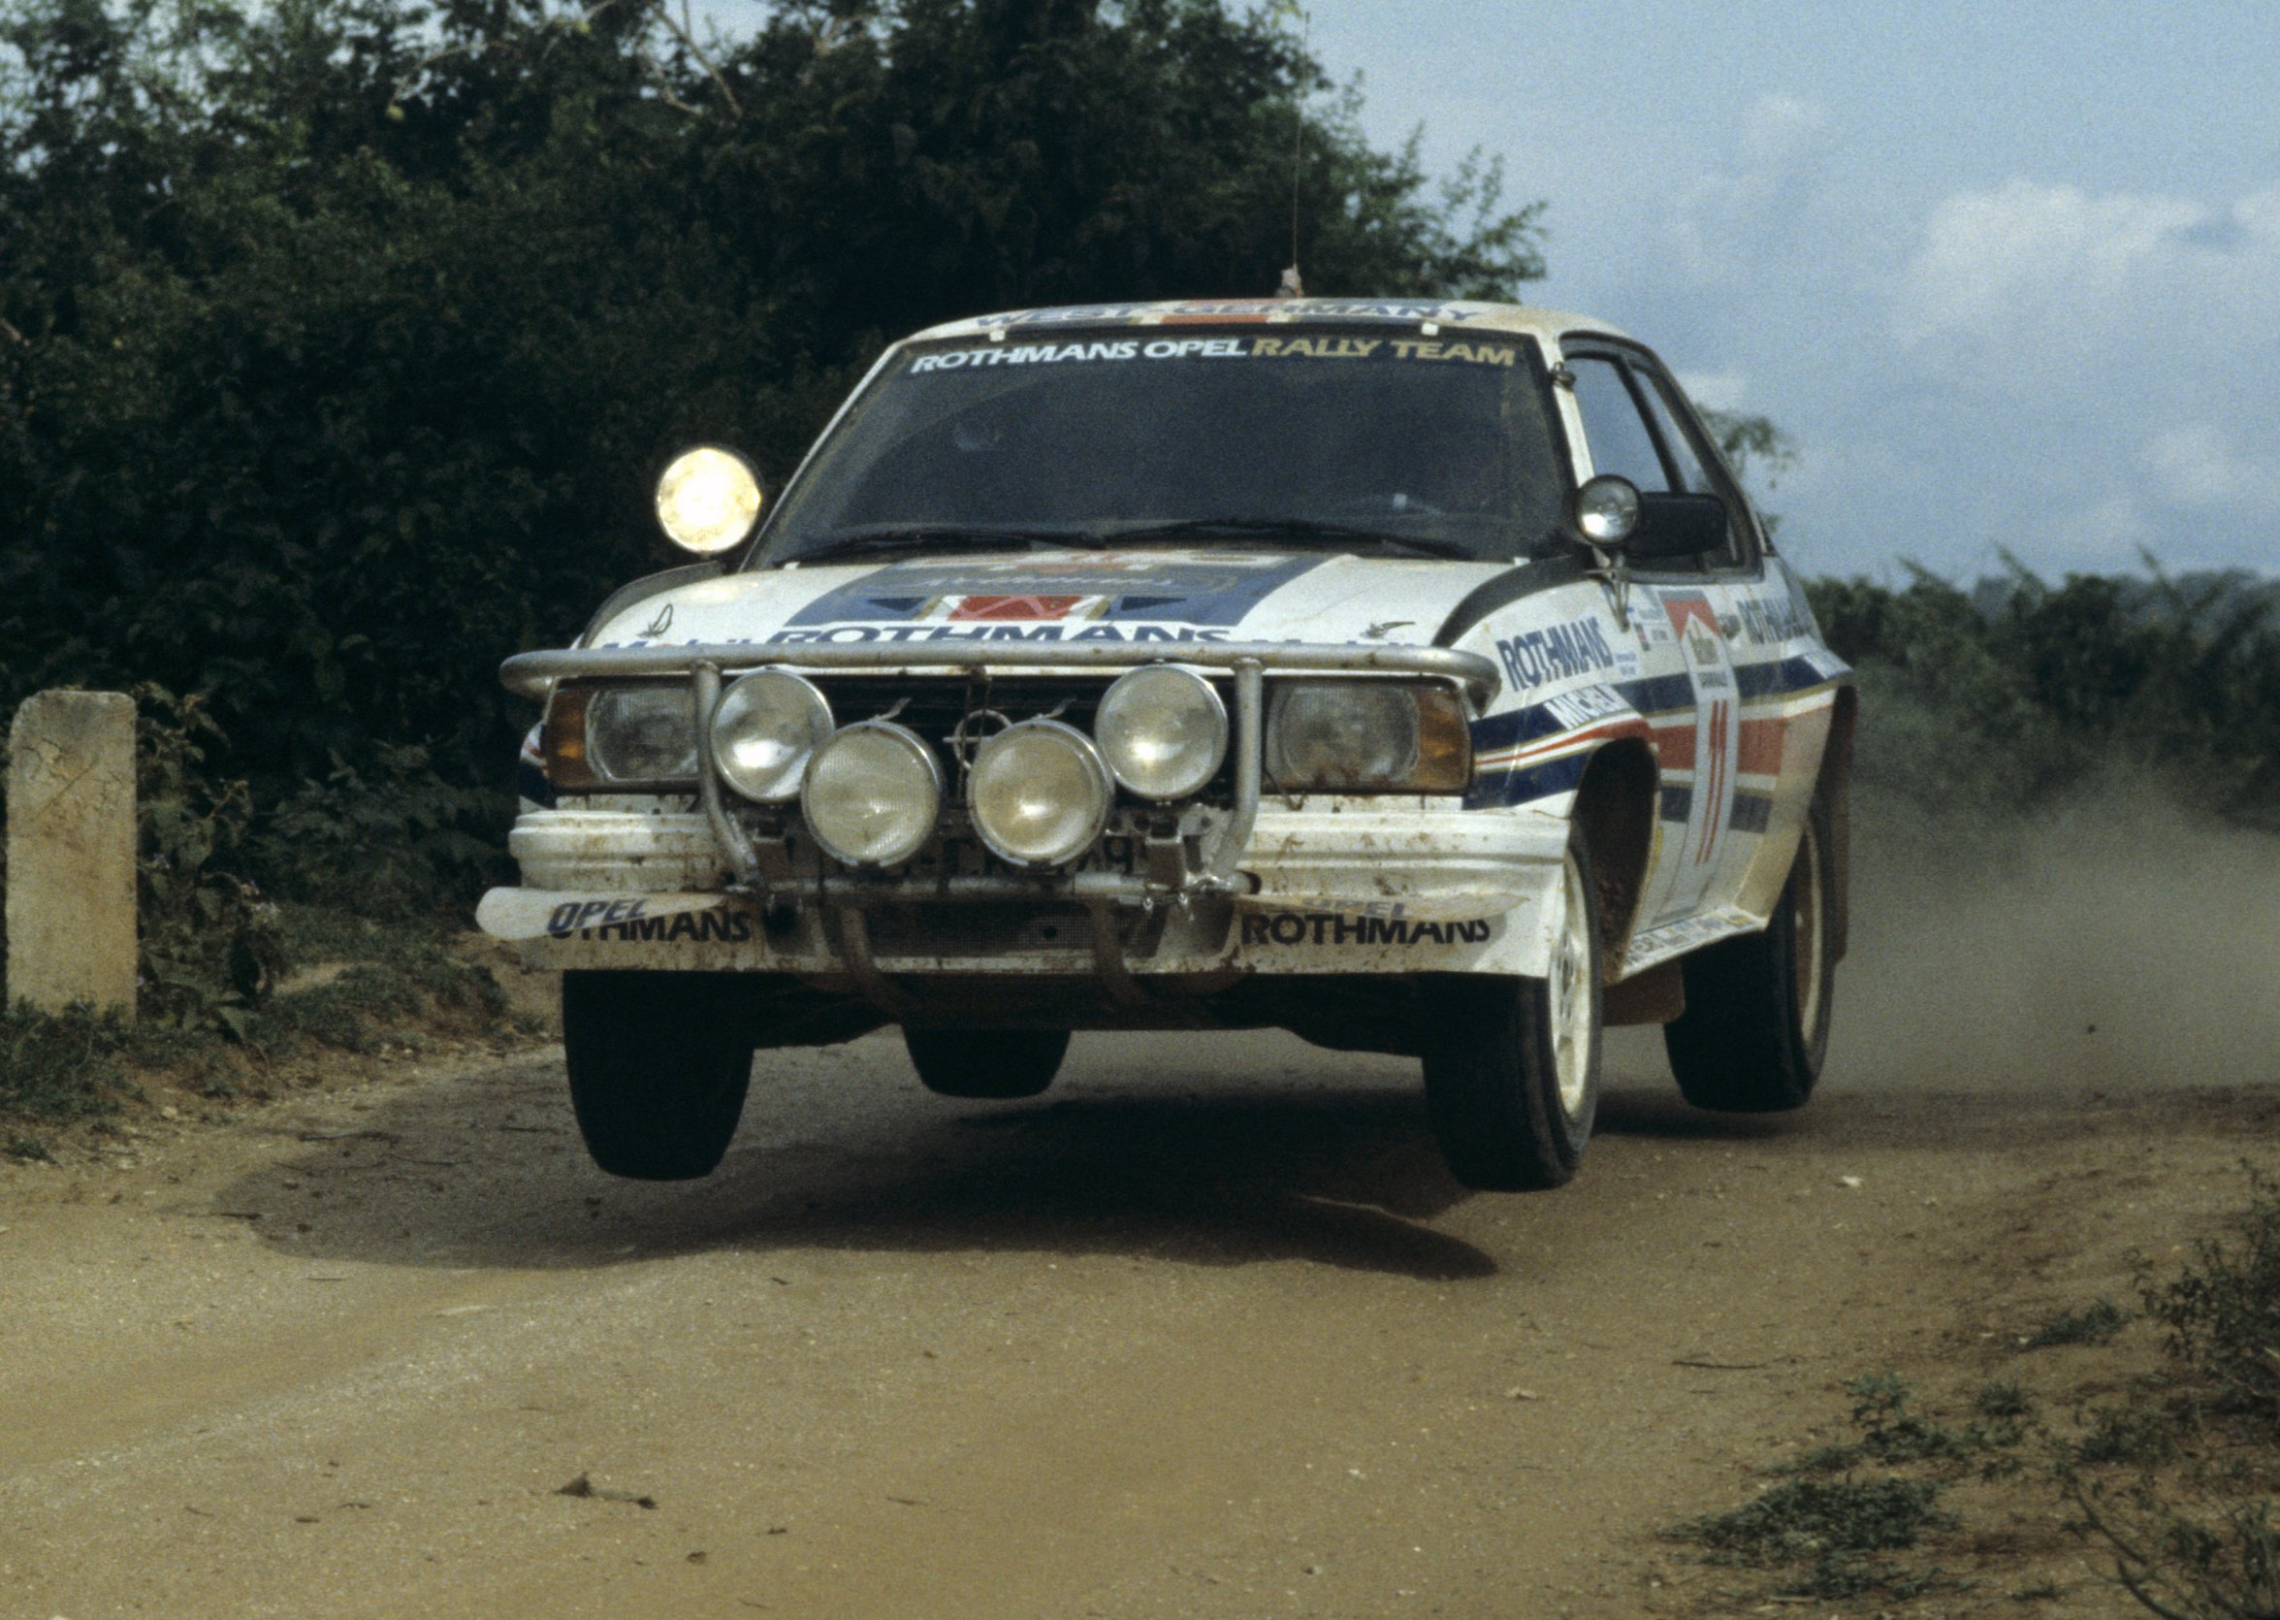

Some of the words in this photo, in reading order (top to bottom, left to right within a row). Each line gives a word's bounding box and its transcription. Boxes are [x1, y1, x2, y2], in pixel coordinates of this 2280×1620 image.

[911, 339, 1137, 374] ROTHMANS
[1143, 337, 1247, 359] OPEL
[1252, 337, 1380, 357] RALLY
[1397, 339, 1515, 366] TEAM
[1496, 616, 1614, 692] ROTHMANS
[547, 900, 648, 931] OPEL
[1240, 912, 1490, 944] ROTHMANS
